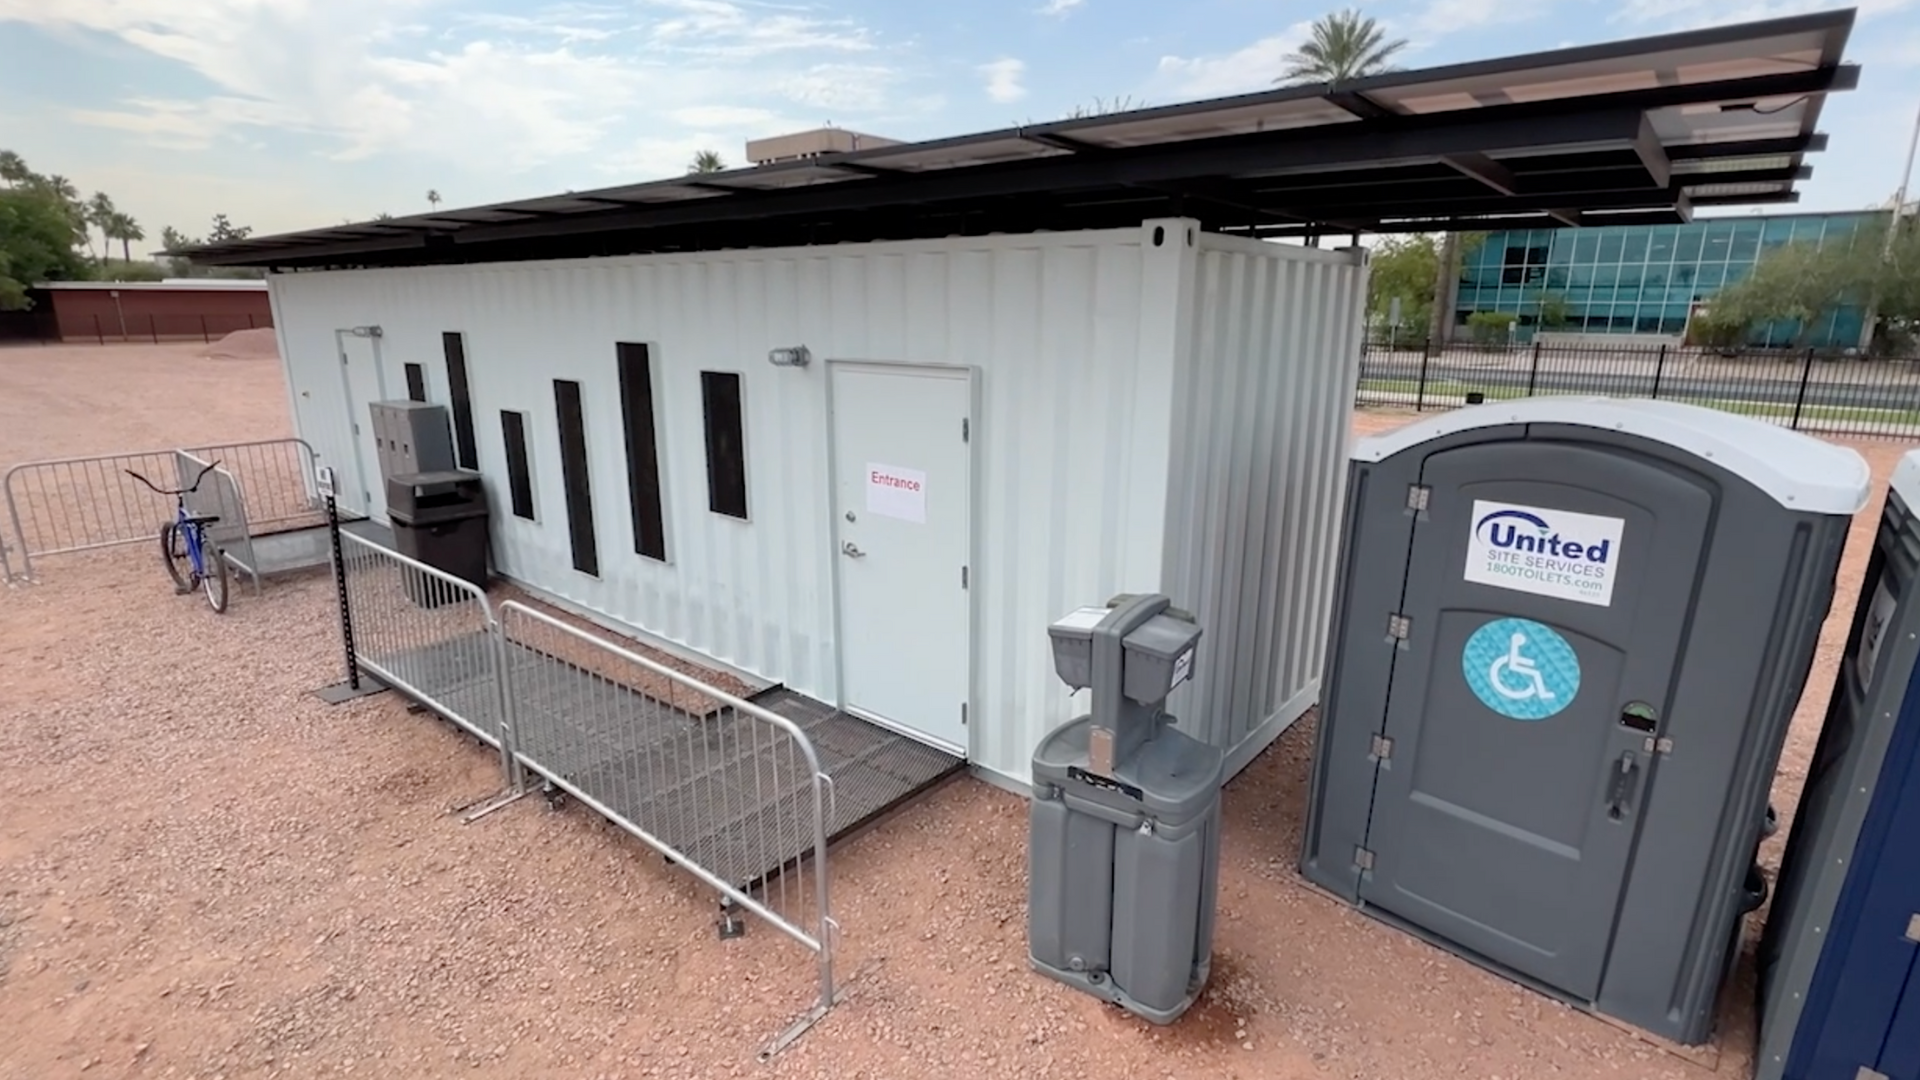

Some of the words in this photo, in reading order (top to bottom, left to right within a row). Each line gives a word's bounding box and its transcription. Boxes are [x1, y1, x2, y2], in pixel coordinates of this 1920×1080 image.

[871, 471, 920, 492] Entrance
[1490, 523, 1610, 564] United
[1486, 562, 1603, 591] 1800TOILETS.com
[1487, 549, 1520, 565] SITE
[1525, 555, 1605, 579] SERVICES
